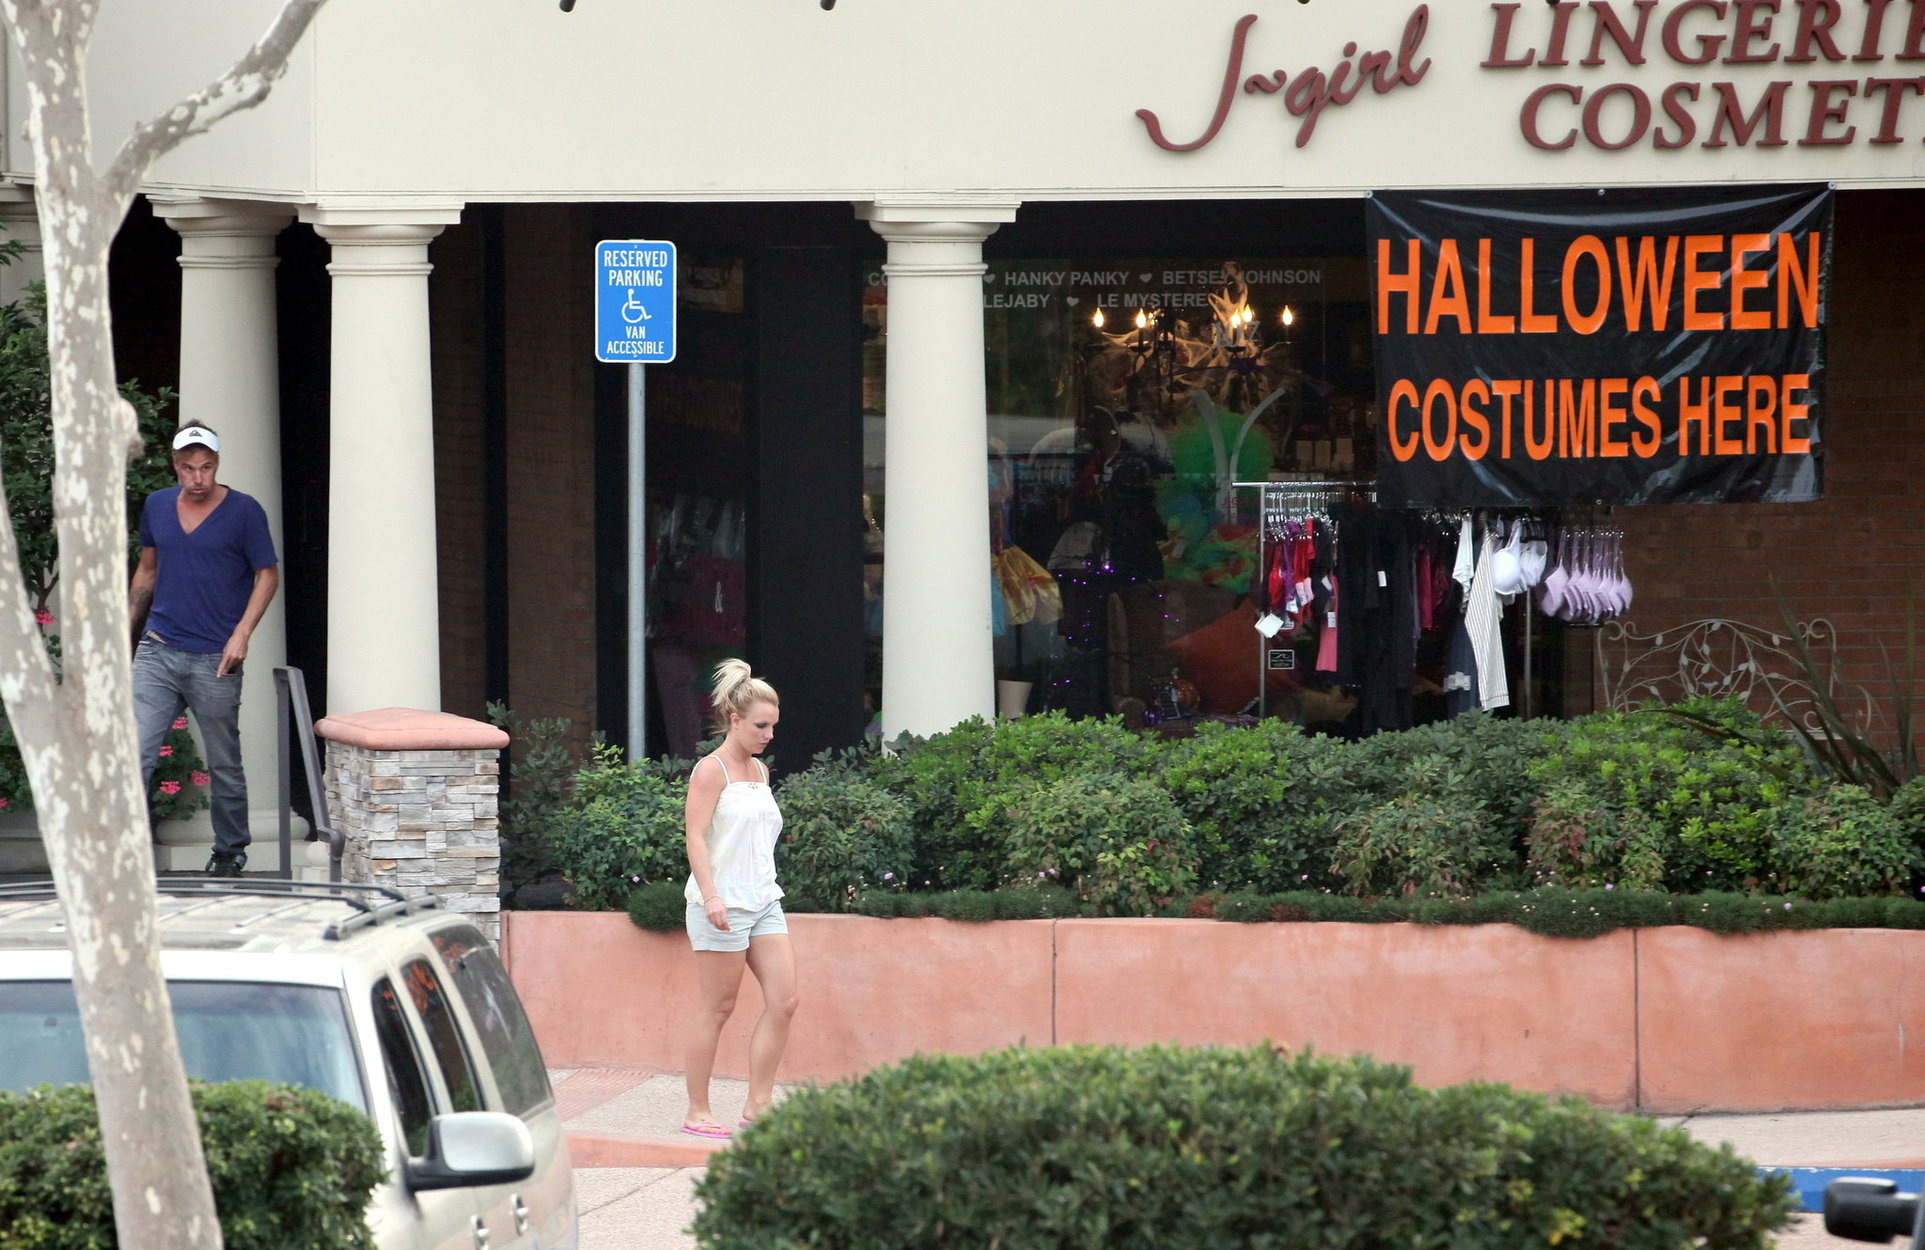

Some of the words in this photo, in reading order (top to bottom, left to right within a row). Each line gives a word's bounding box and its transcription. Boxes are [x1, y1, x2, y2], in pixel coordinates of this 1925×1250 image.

[1520, 77, 1925, 149] COSMET
[604, 250, 668, 267] RESERVED
[609, 270, 663, 287] PARKING
[1004, 271, 1066, 286] HANKY
[1071, 271, 1129, 286] PANKY
[1377, 232, 1820, 335] HALLOWEEN
[983, 294, 1050, 308] LEJABY
[1097, 293, 1119, 308] LE
[1124, 293, 1210, 307] MYSTERE
[625, 326, 646, 339] VAN
[606, 341, 665, 354] ACCESSIBLE
[1387, 375, 1662, 462] COSTUMES
[1679, 373, 1812, 457] HERE
